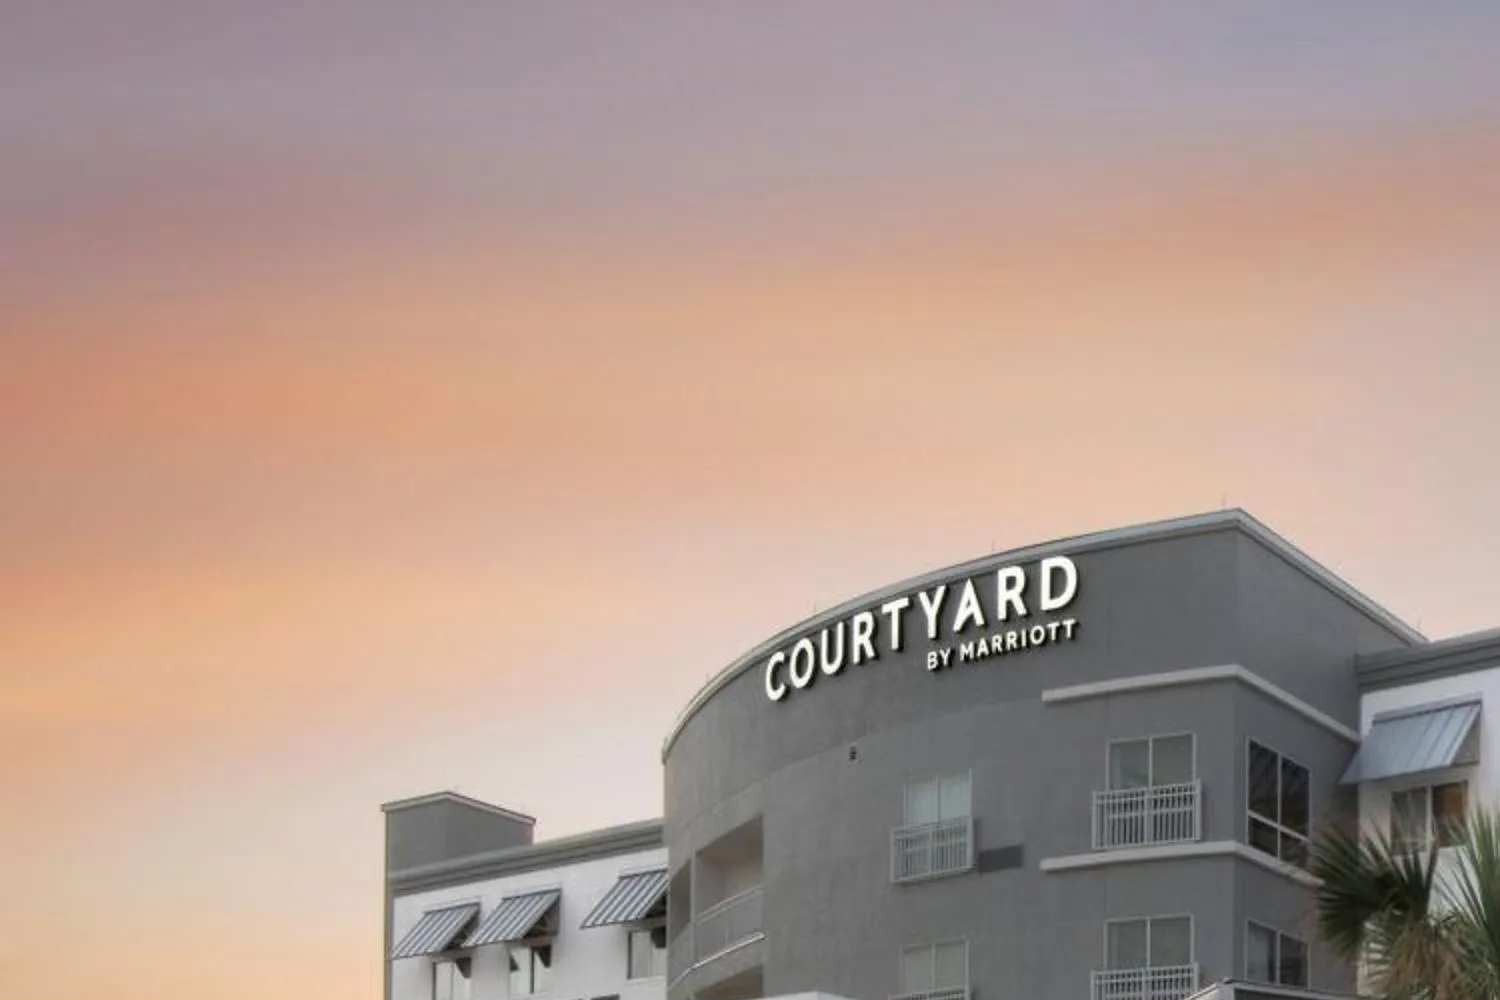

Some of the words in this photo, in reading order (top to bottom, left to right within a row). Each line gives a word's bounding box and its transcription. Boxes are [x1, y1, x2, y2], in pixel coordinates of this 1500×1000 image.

[764, 555, 1078, 701] COURTYARD
[926, 650, 951, 671] BY
[959, 618, 1077, 661] MARRIOTT
